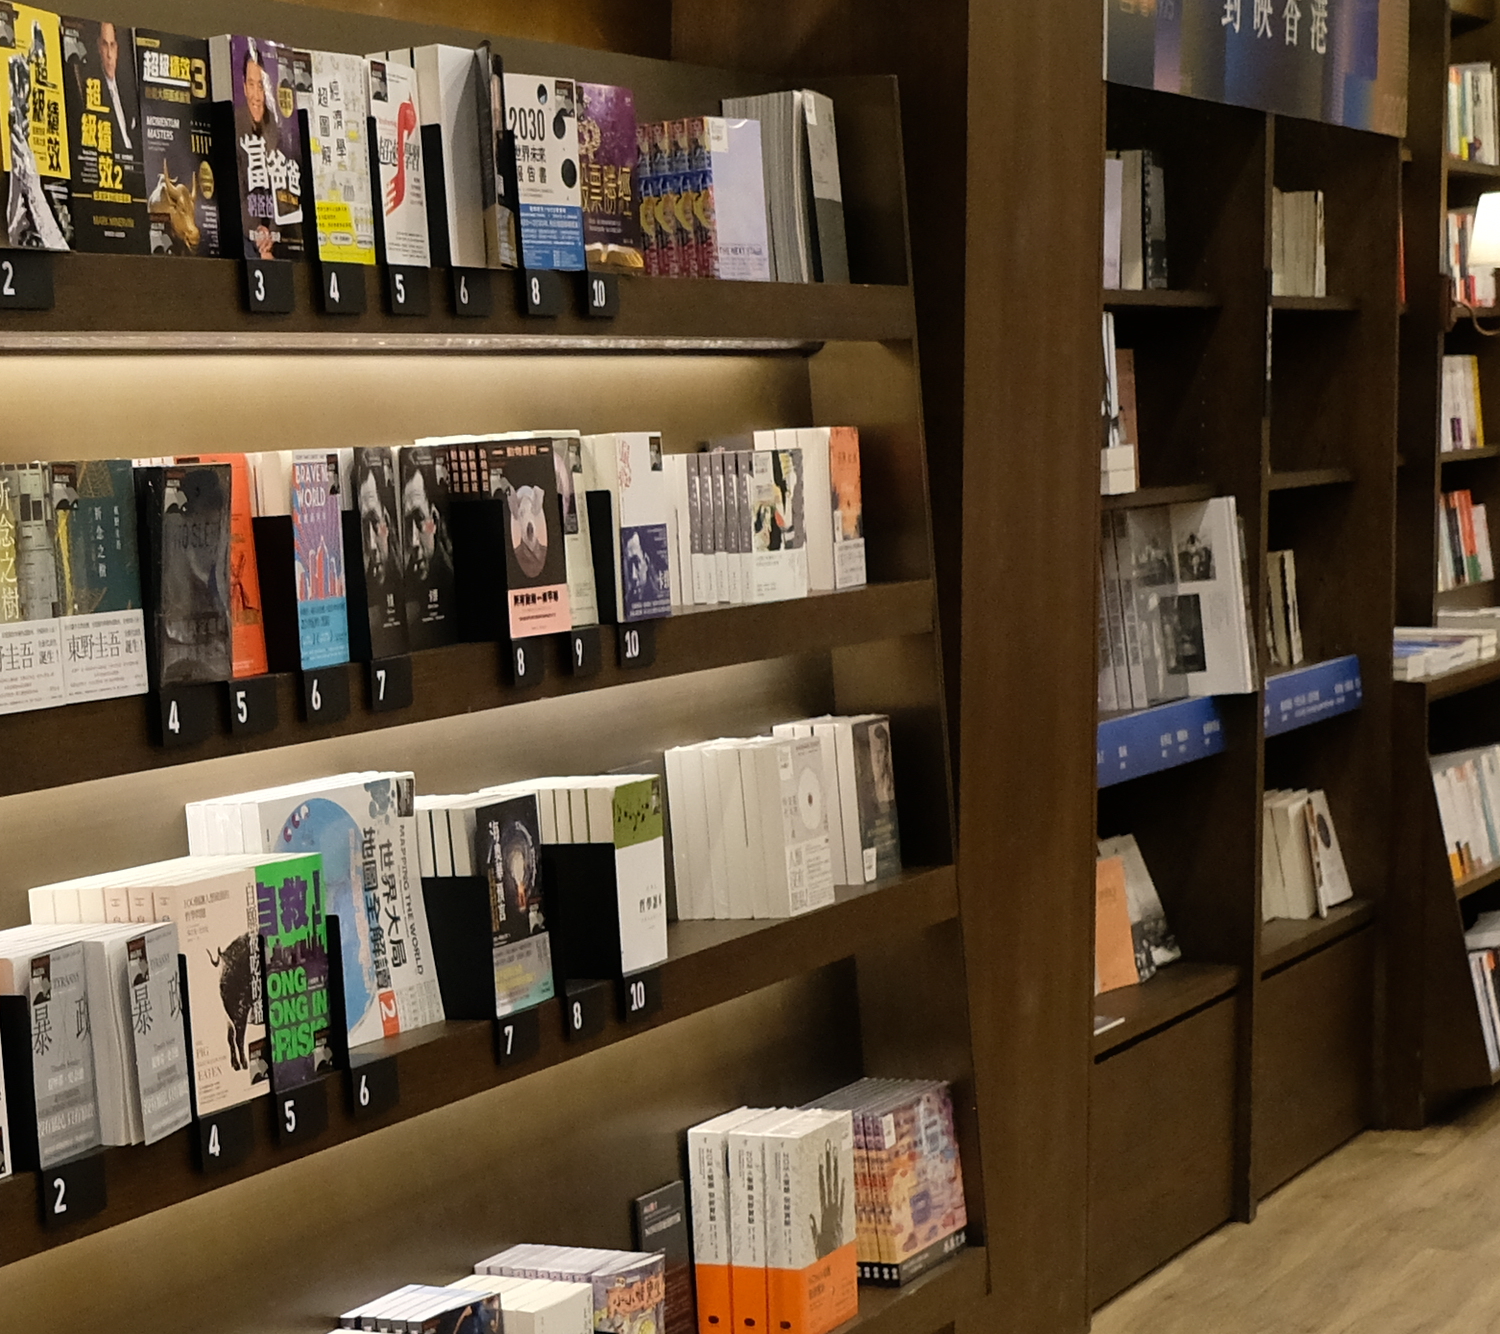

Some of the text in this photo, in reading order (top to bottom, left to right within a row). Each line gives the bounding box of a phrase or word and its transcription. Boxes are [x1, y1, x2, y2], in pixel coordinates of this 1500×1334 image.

[509, 106, 547, 142] 2030
[2, 260, 15, 297] 2
[254, 270, 266, 302] 3
[329, 273, 340, 303] 4
[395, 274, 406, 304] 5
[459, 275, 469, 305] 6
[531, 277, 541, 306] 8
[592, 278, 606, 308] 10
[293, 463, 318, 483] BRAVE
[295, 488, 327, 509] WORLD
[66, 630, 122, 663] 東野圭吾
[575, 638, 583, 667] 9
[624, 629, 639, 659] 10
[515, 647, 526, 676] 8
[311, 681, 322, 711] 6
[376, 671, 387, 702] 7
[168, 700, 180, 735] 4
[236, 696, 248, 724] 5
[361, 825, 392, 988] 地圖全解讀
[378, 839, 410, 969] 世界大局
[629, 980, 646, 1011] 10
[573, 1000, 583, 1030] 8
[503, 1025, 515, 1056] 7
[358, 1075, 370, 1108] 6
[284, 1101, 297, 1133] 5
[207, 1123, 221, 1158] 4
[53, 1180, 67, 1215] 2
